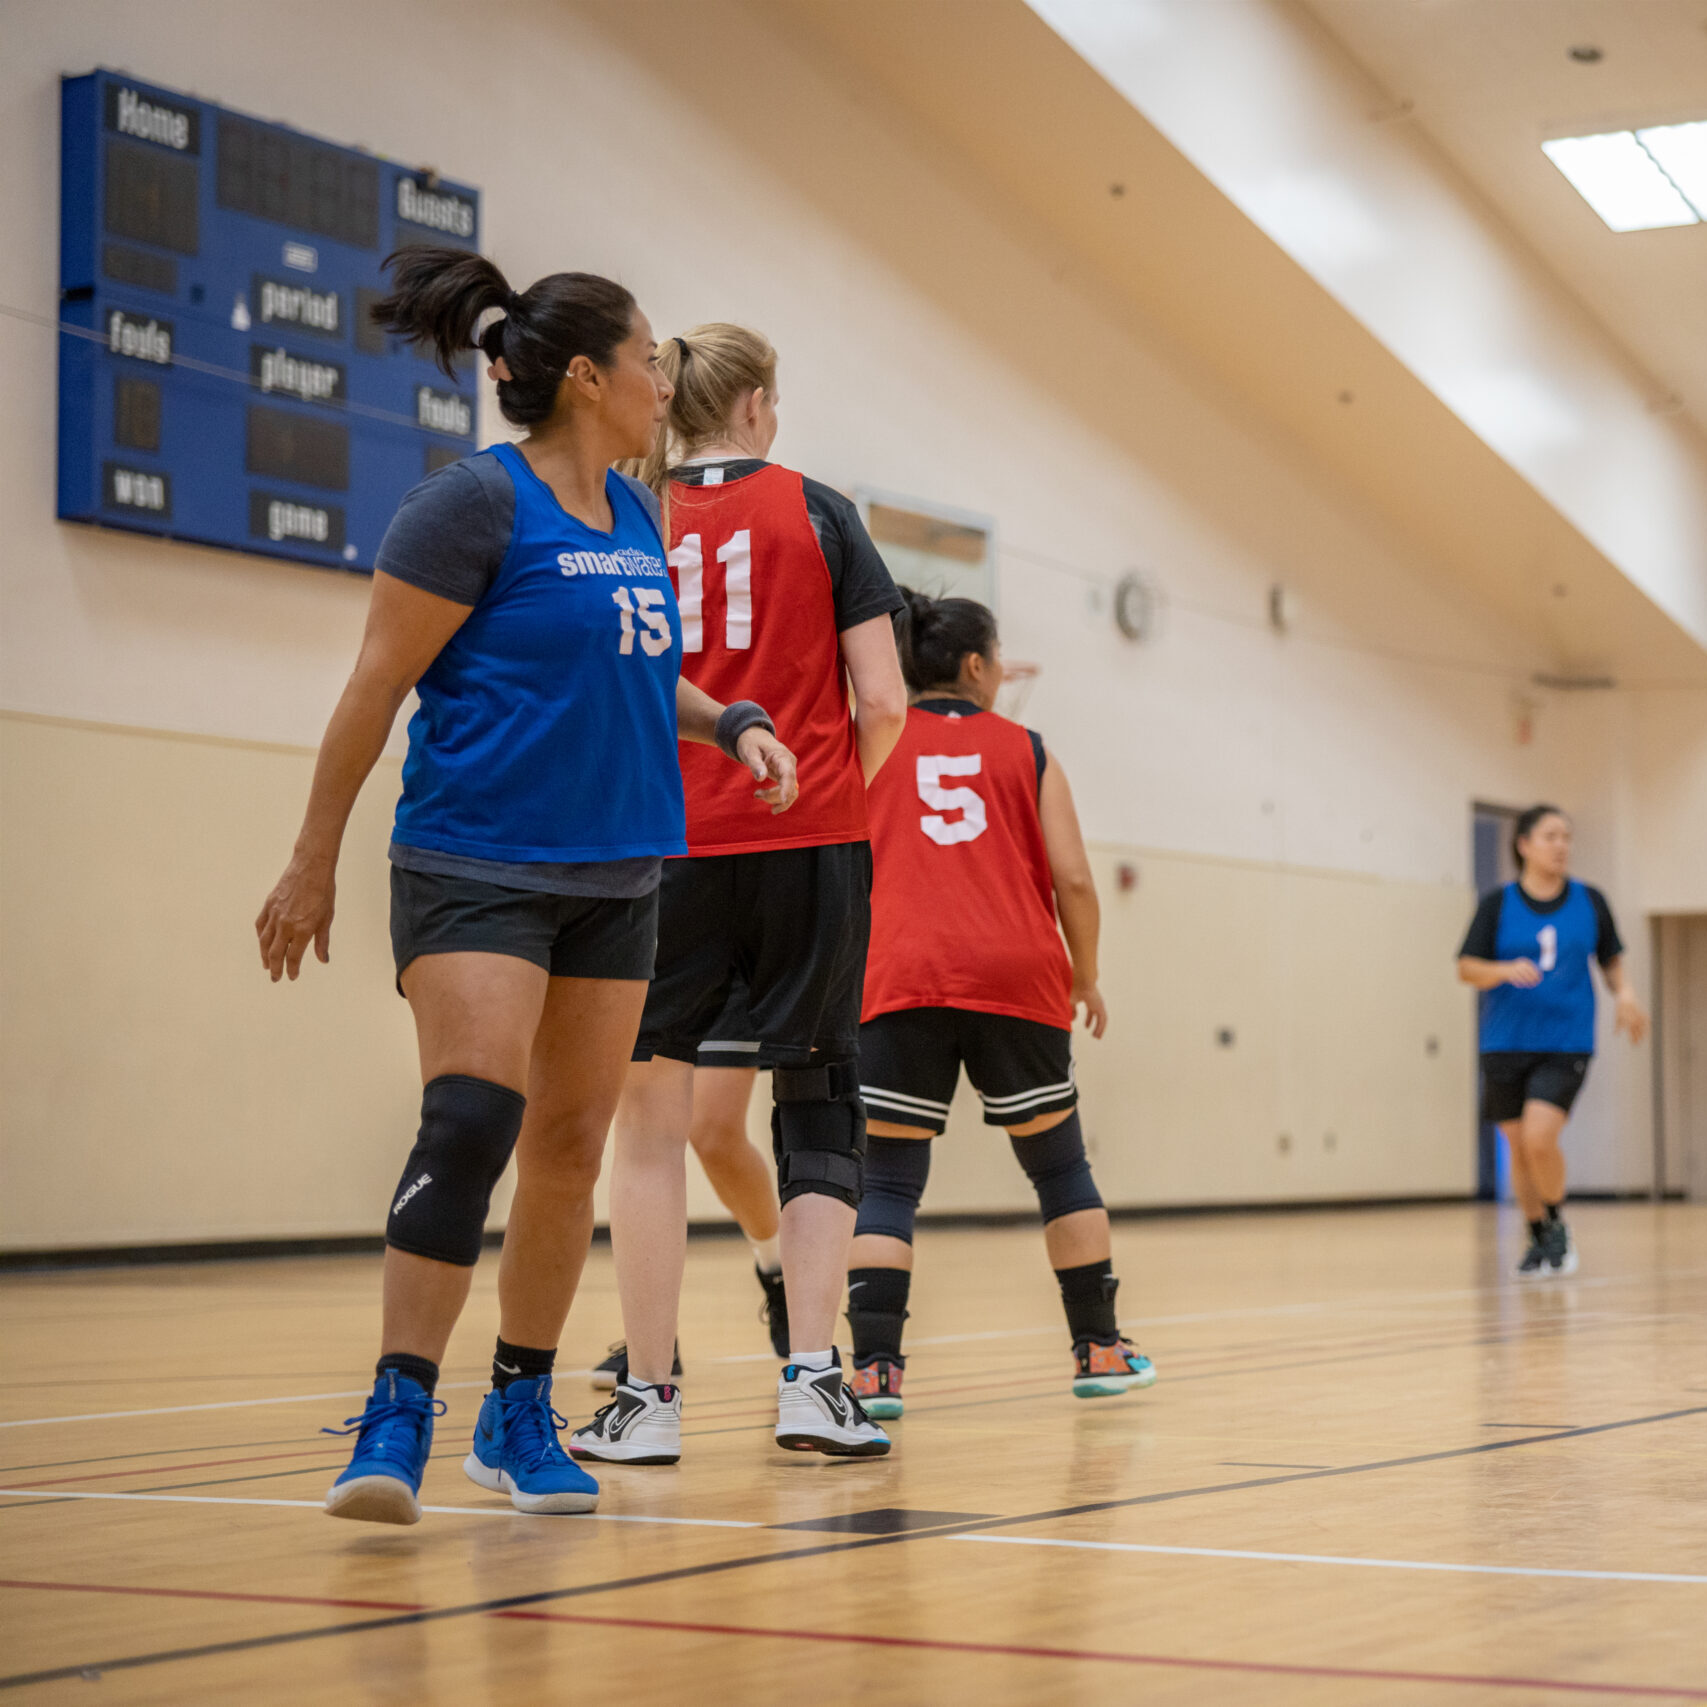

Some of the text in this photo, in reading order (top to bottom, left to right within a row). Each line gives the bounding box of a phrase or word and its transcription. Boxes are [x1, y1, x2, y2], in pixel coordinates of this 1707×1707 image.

[118, 88, 189, 149] Home
[398, 178, 474, 237] Guests
[261, 280, 338, 332] period
[110, 311, 171, 365] fouls
[260, 349, 339, 401] player
[417, 387, 471, 436] fouls
[113, 469, 165, 511] won
[268, 500, 329, 542] game
[668, 529, 752, 653] 11
[612, 586, 672, 657] 15
[916, 753, 988, 845] 5
[1536, 924, 1558, 972] 1
[393, 1173, 433, 1215] ROGUE
